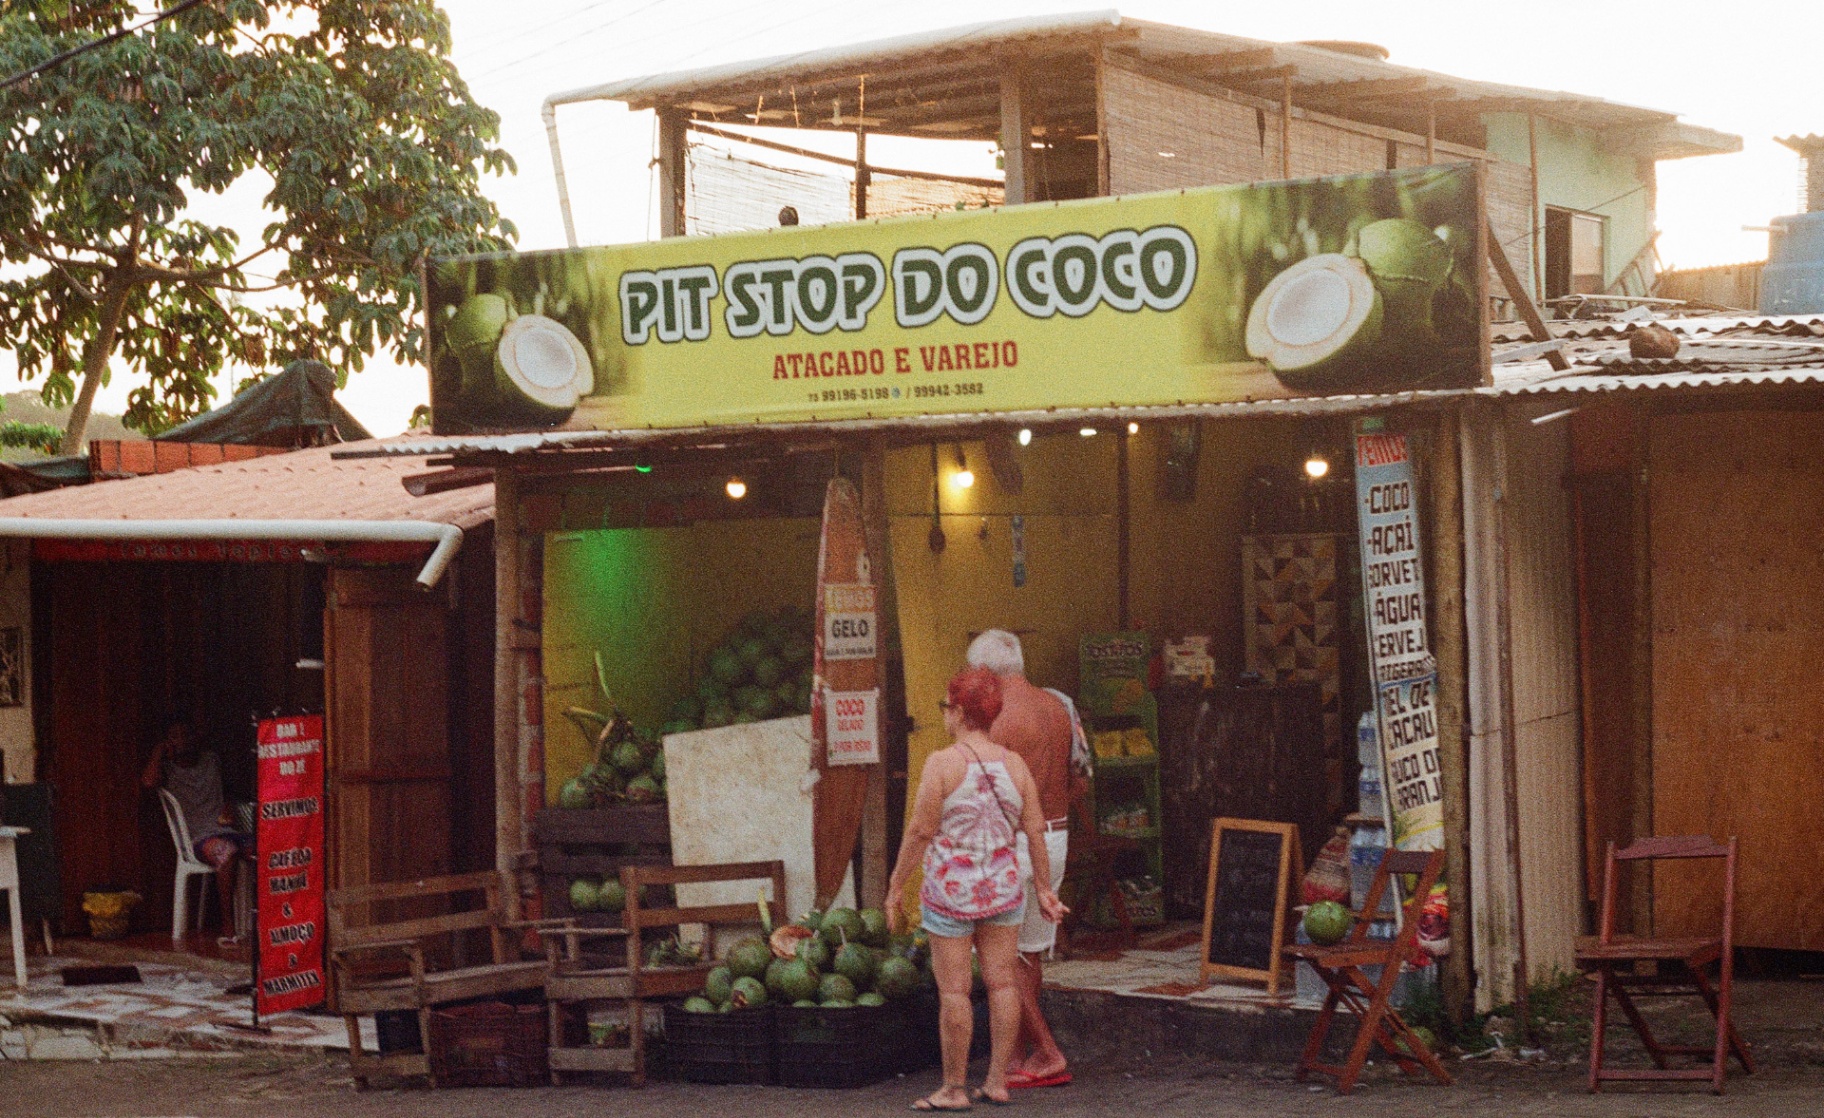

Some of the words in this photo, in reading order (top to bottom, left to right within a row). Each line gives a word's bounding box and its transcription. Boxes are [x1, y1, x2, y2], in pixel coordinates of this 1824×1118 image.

[620, 265, 719, 344] PIT
[723, 253, 885, 338] STOP
[892, 243, 998, 327] DO
[1005, 225, 1197, 318] COCO
[773, 348, 884, 379] ATACADO
[894, 348, 911, 373] E
[919, 341, 1018, 372] VAREJO
[1370, 481, 1410, 514] COCO
[1375, 591, 1421, 626] ÁGUA
[832, 618, 869, 639] GELO
[276, 722, 298, 739] BAR
[261, 796, 320, 820] SERVIMOS
[270, 921, 314, 947] ALMOÇO
[262, 969, 320, 995] MARMITEX
